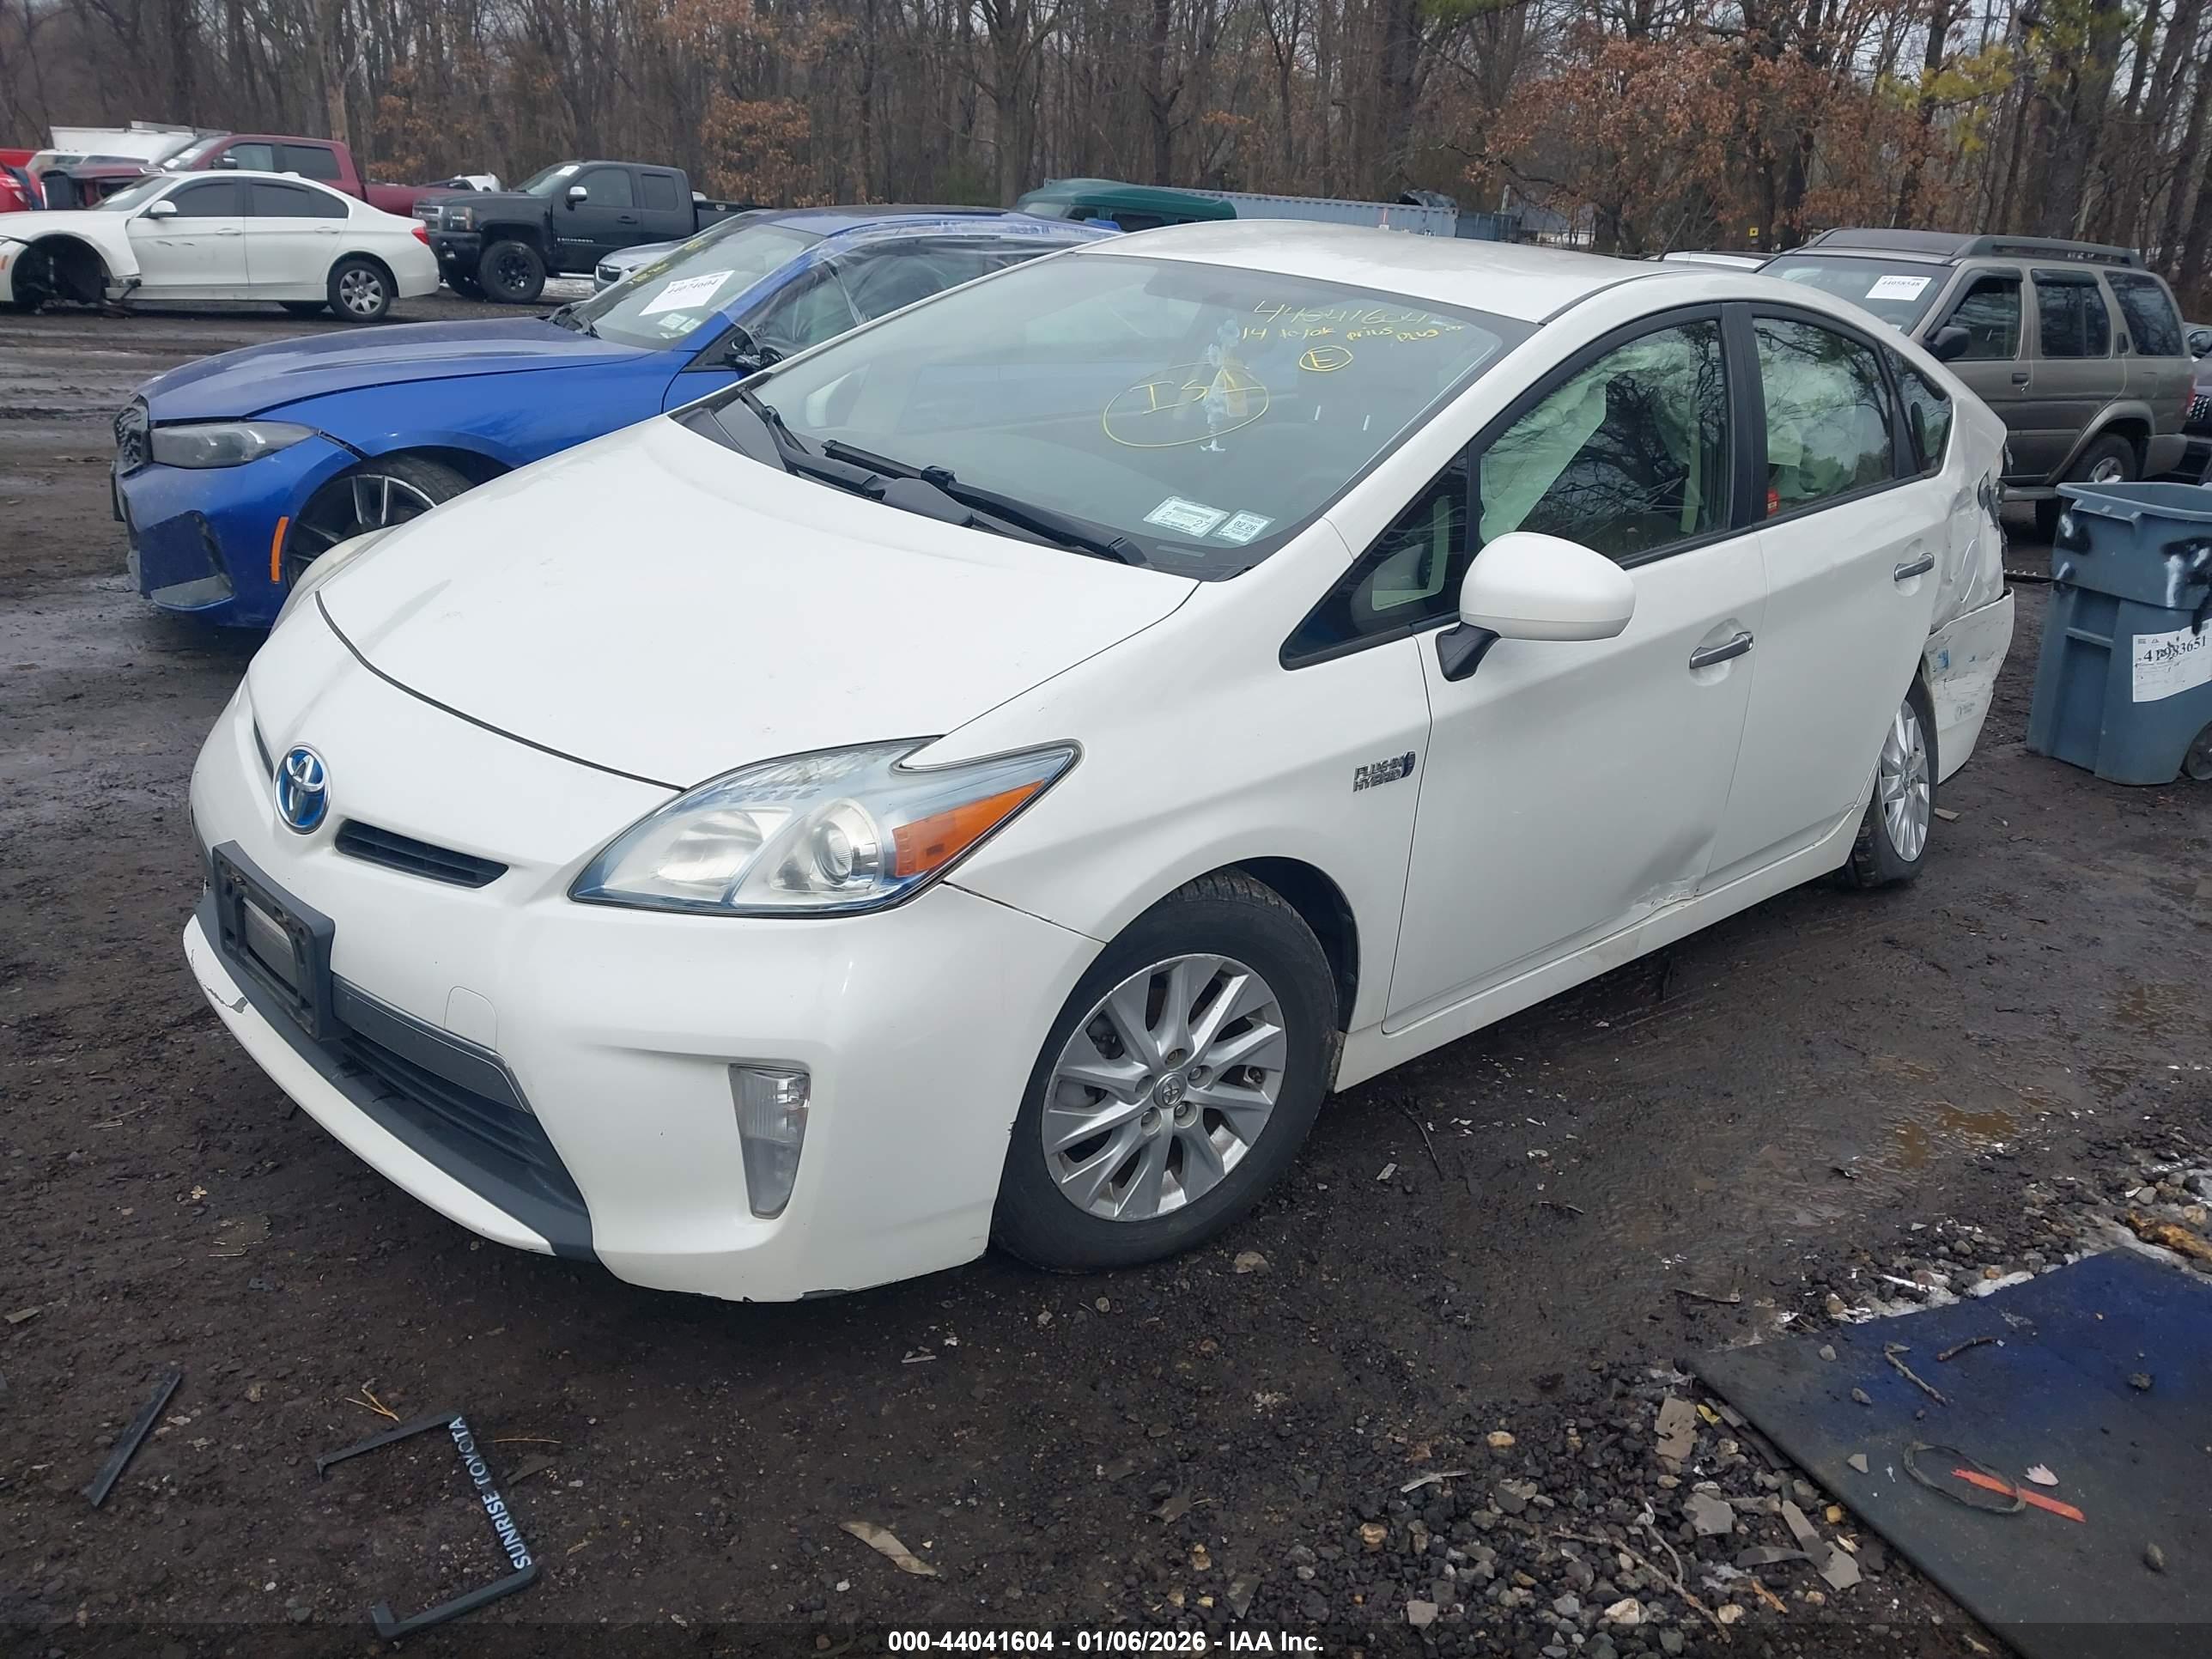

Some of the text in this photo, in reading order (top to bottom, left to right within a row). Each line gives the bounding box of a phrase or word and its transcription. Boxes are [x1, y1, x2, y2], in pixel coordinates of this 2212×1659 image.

[1243, 327, 1267, 340] 14
[449, 1416, 532, 1570] SUNRISE TOYOTA
